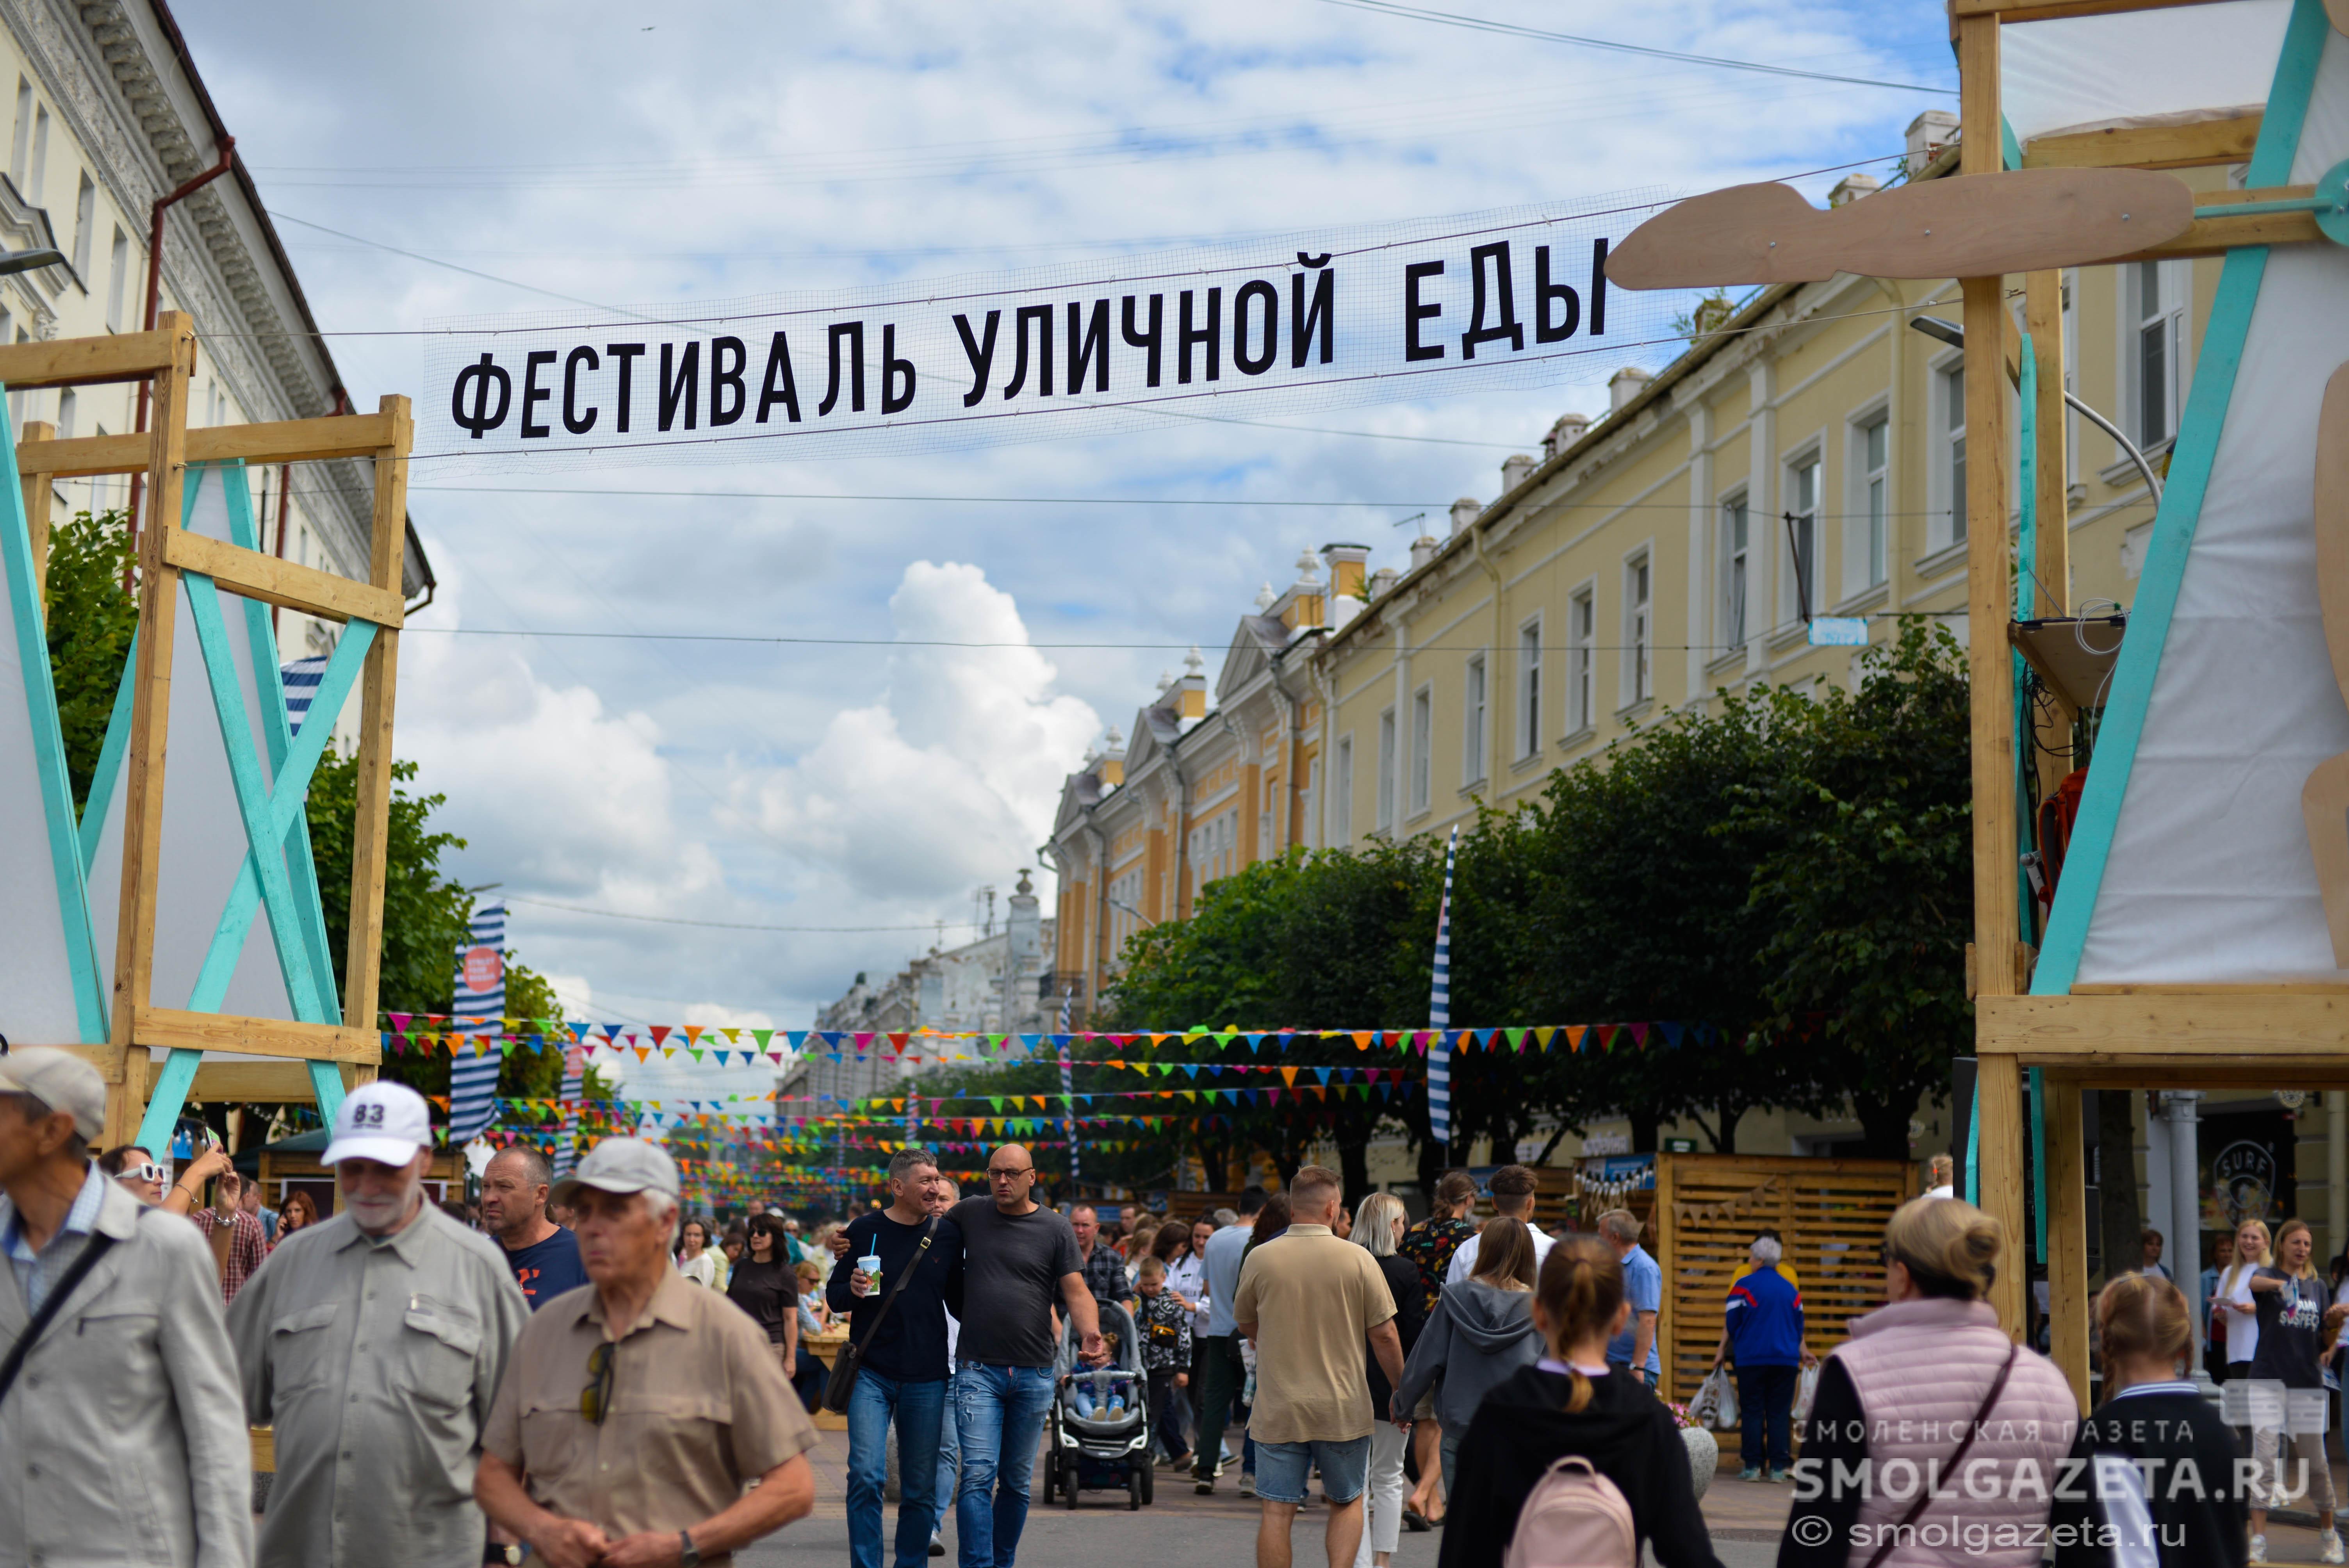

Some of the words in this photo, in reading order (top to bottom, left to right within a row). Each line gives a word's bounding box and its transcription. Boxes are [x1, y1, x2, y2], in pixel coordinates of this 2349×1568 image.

[452, 321, 916, 439] ФЕСТИВАЛЬ
[952, 252, 1334, 408] УЛИЧНОЙ
[1406, 238, 1608, 362] ЕДЫ
[353, 1104, 385, 1123] 83
[2222, 1150, 2267, 1177] SURF
